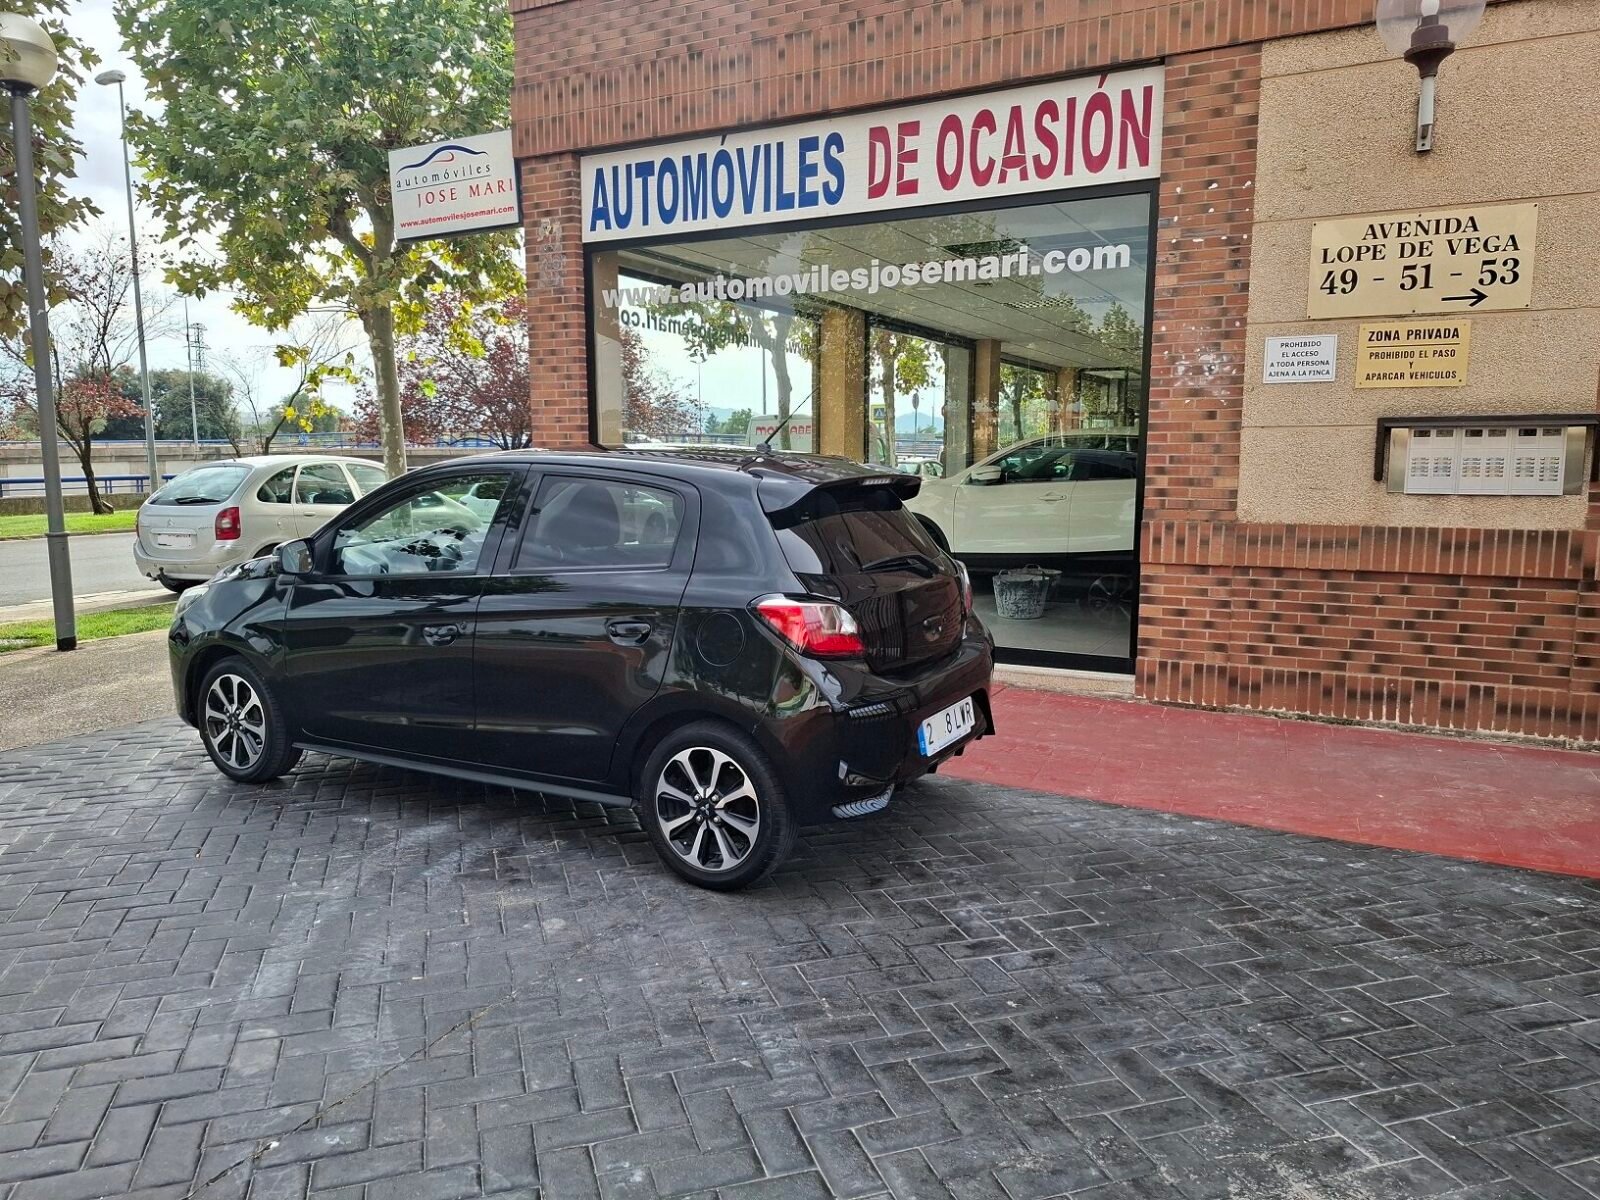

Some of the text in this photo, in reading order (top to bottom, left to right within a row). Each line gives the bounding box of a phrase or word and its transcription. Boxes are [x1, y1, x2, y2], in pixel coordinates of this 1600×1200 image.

[589, 73, 1154, 232] AUTOMÓVILES DE OCASIÓN
[396, 163, 491, 188] automóviles
[417, 178, 514, 208] JOSE MARI
[400, 205, 515, 228] www.automovilesjosemari.com
[1361, 215, 1480, 241] AVENIDA
[1321, 234, 1520, 265] LOPE DE VEGA
[602, 243, 1131, 309] www.automovilesjosemari.com
[1319, 268, 1358, 295] 49
[1399, 263, 1434, 291] 51
[1478, 257, 1520, 287] 53
[1368, 327, 1460, 342] ZONA PRIVADA
[1280, 340, 1322, 349] PROHIBIDO
[1291, 350, 1319, 358] ACCESO
[1369, 348, 1456, 360] PROHIBIDO EL PASO
[1296, 359, 1330, 367] PERSONA
[1298, 369, 1307, 377] LA
[1308, 368, 1330, 376] FINCA
[1408, 361, 1414, 369] Y
[1365, 370, 1457, 381] APARCAR VEHICULOS
